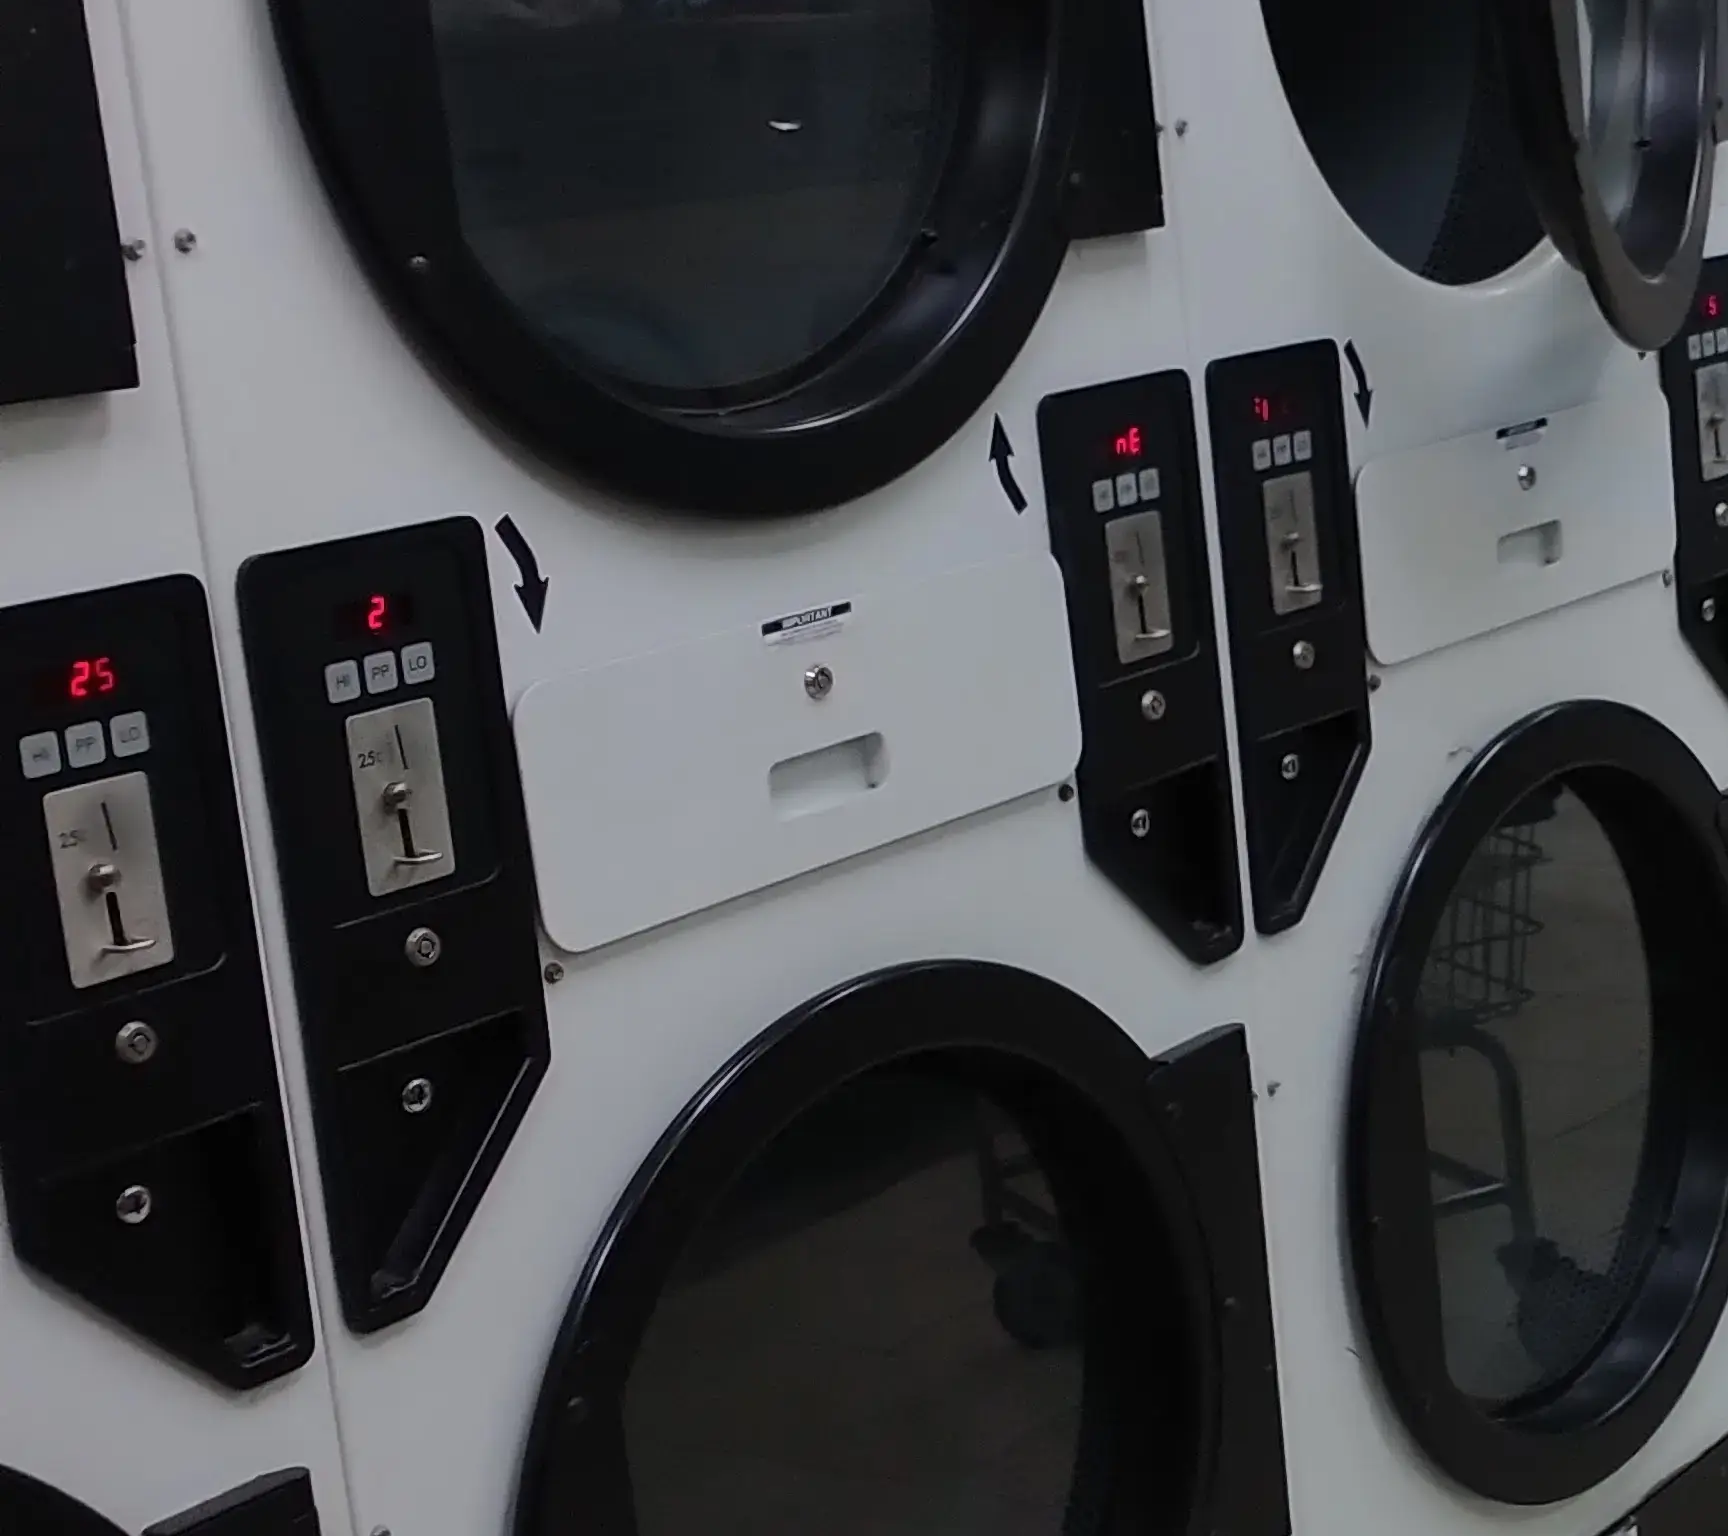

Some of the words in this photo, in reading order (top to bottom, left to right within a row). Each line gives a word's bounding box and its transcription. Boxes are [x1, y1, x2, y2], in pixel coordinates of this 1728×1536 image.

[367, 595, 386, 630] 2
[70, 656, 115, 696] 25
[408, 655, 428, 672] LO
